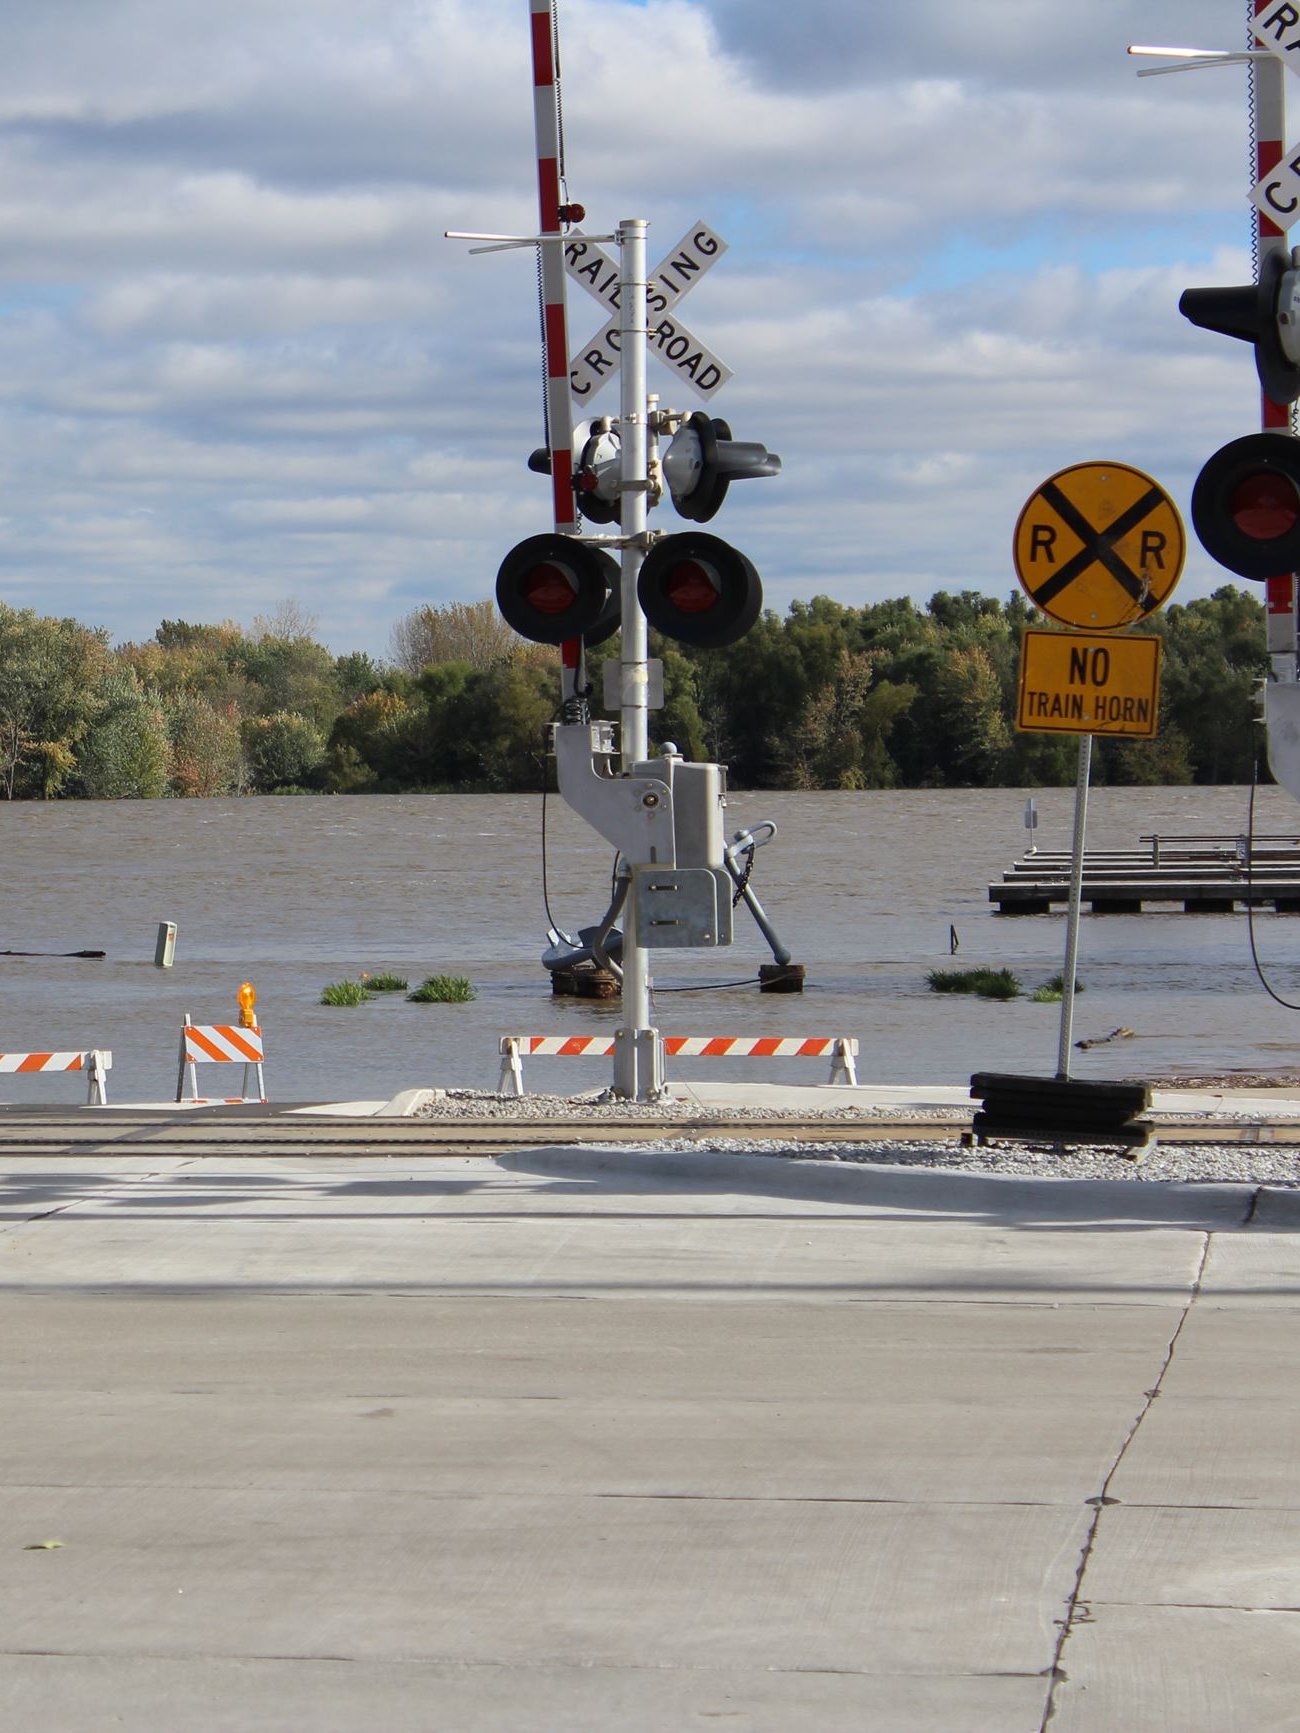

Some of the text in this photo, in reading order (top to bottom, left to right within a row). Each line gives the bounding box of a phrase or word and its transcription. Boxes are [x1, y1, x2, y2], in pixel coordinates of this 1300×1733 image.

[1030, 524, 1167, 570] R R
[1069, 647, 1110, 687] NO
[1027, 691, 1149, 723] TRAIN HORN
